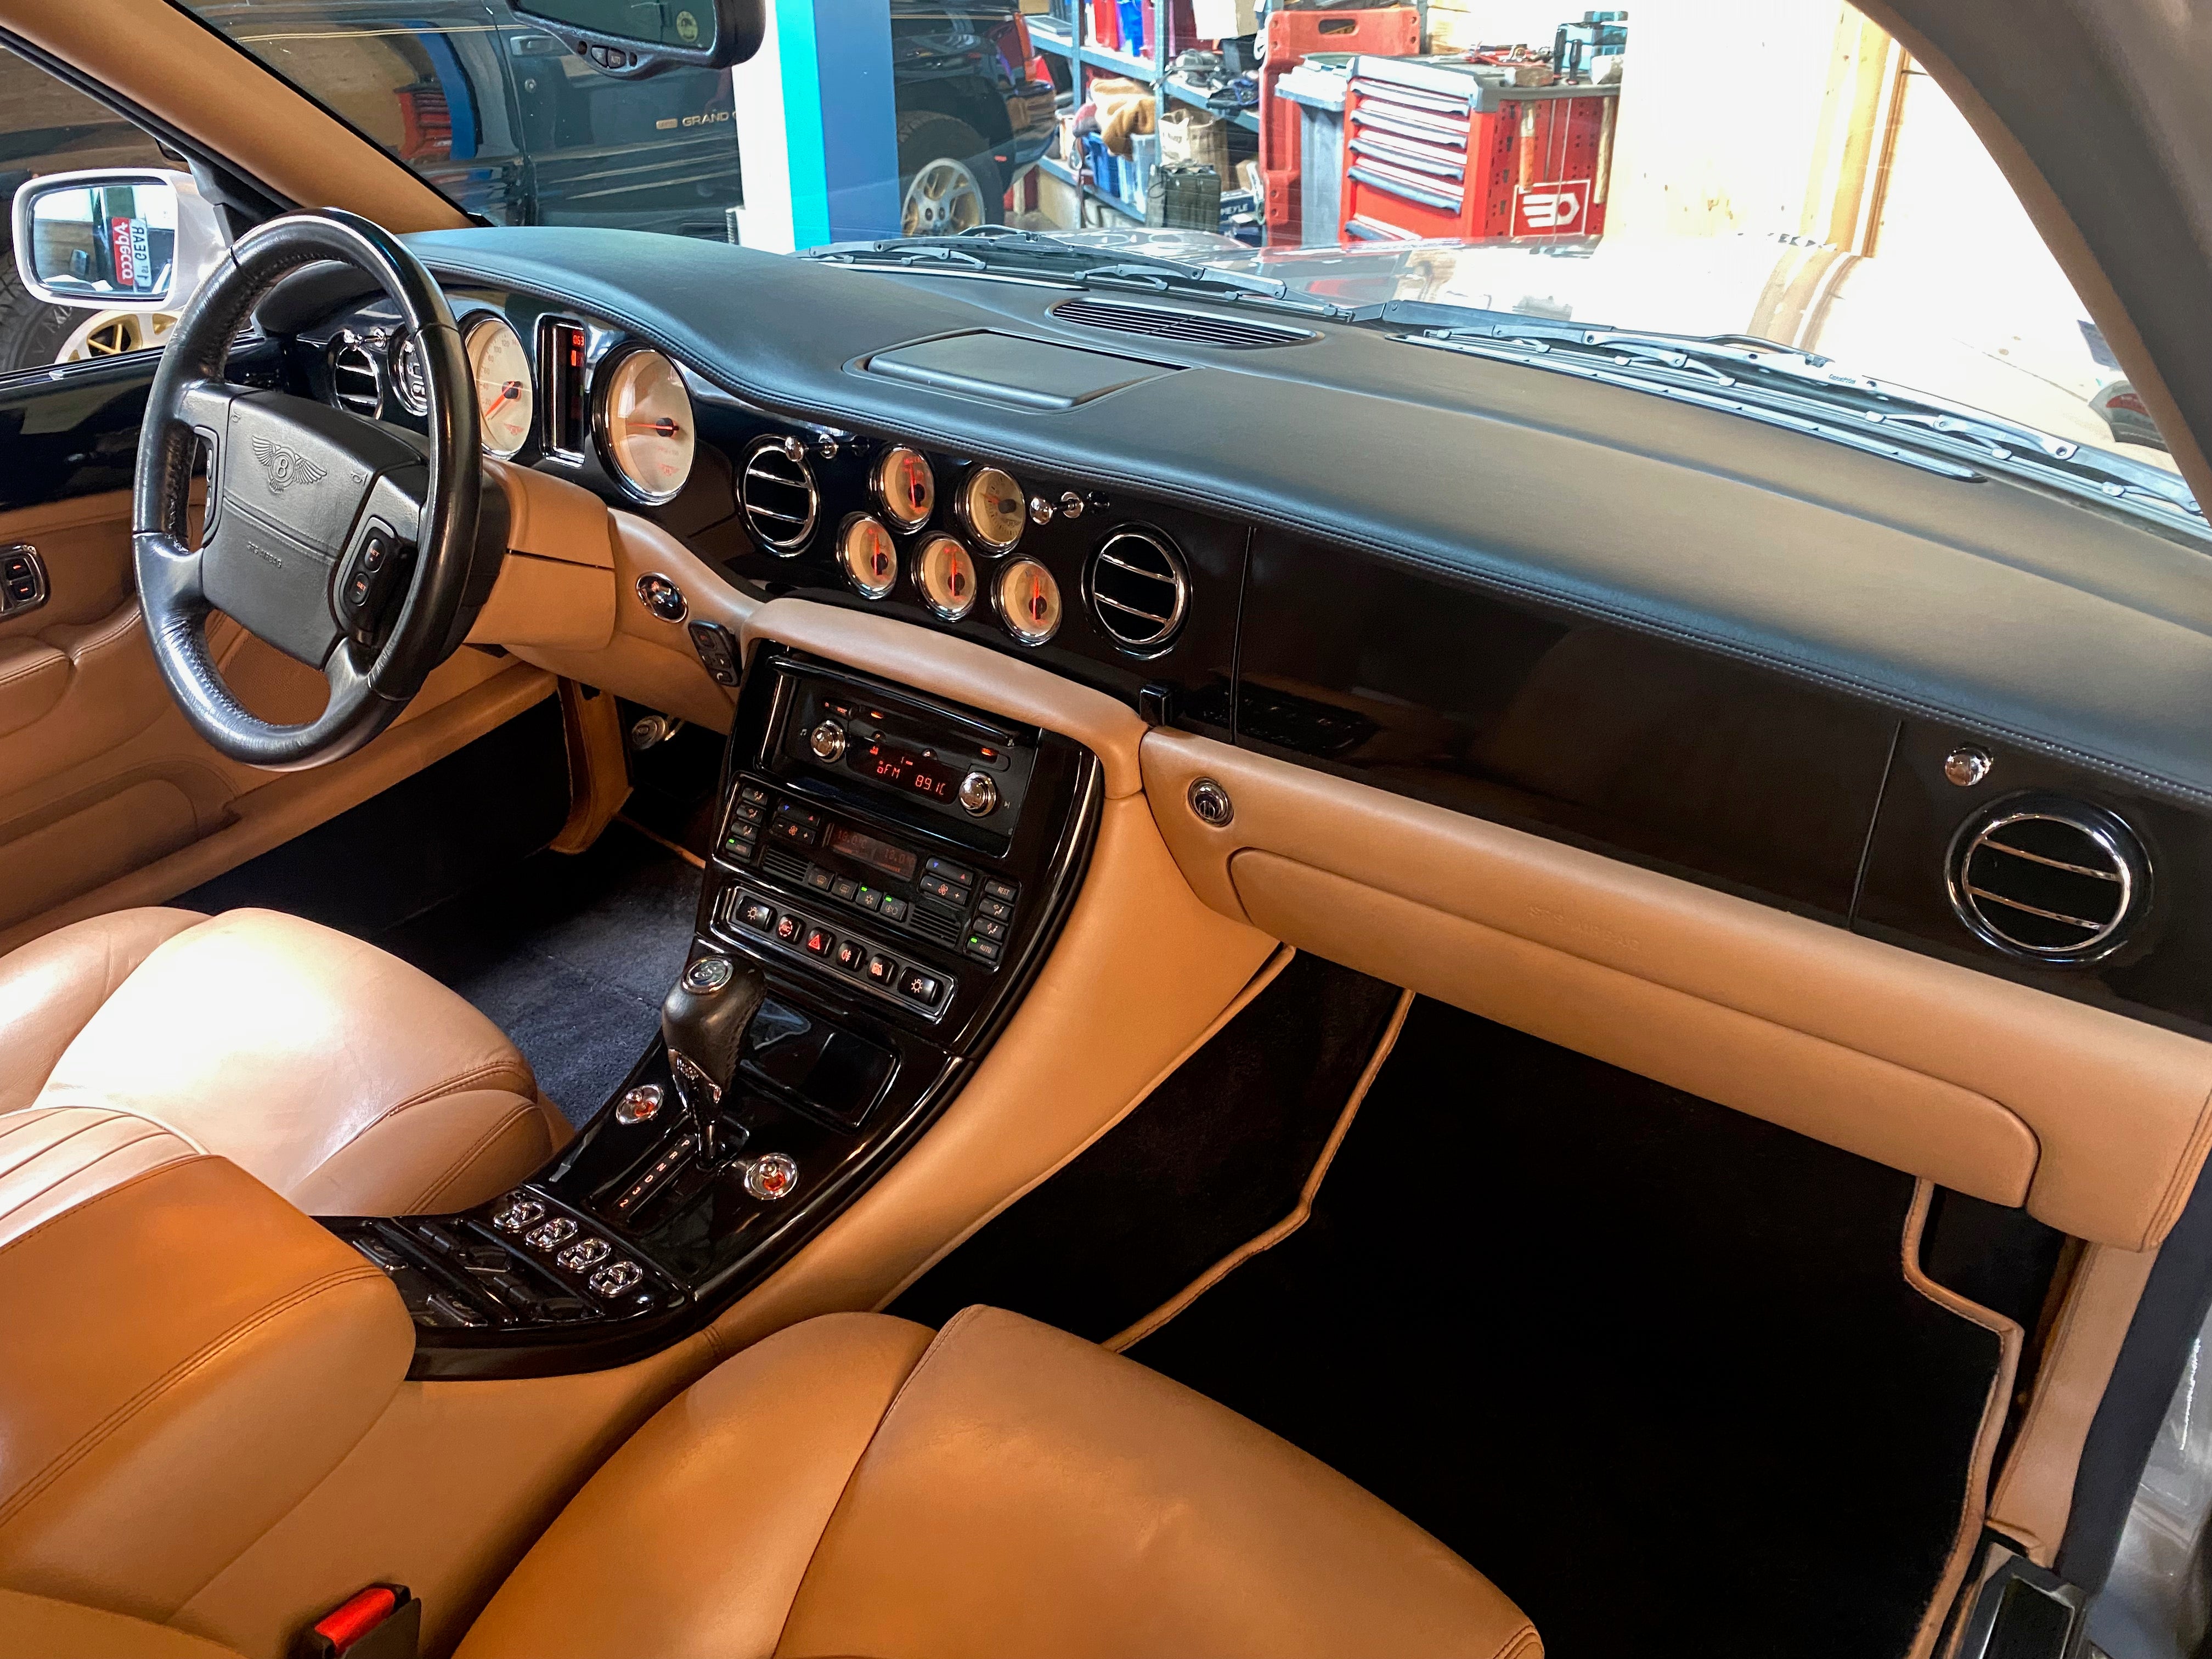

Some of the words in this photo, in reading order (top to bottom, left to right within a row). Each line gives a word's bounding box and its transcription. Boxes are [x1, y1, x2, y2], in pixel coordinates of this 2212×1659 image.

[682, 111, 729, 127] GRAND
[997, 886, 1010, 896] REST
[669, 1151, 678, 1160] R
[656, 1163, 667, 1172] N
[644, 1175, 653, 1183] D
[632, 1187, 641, 1195] 3
[619, 1199, 629, 1207] 2
